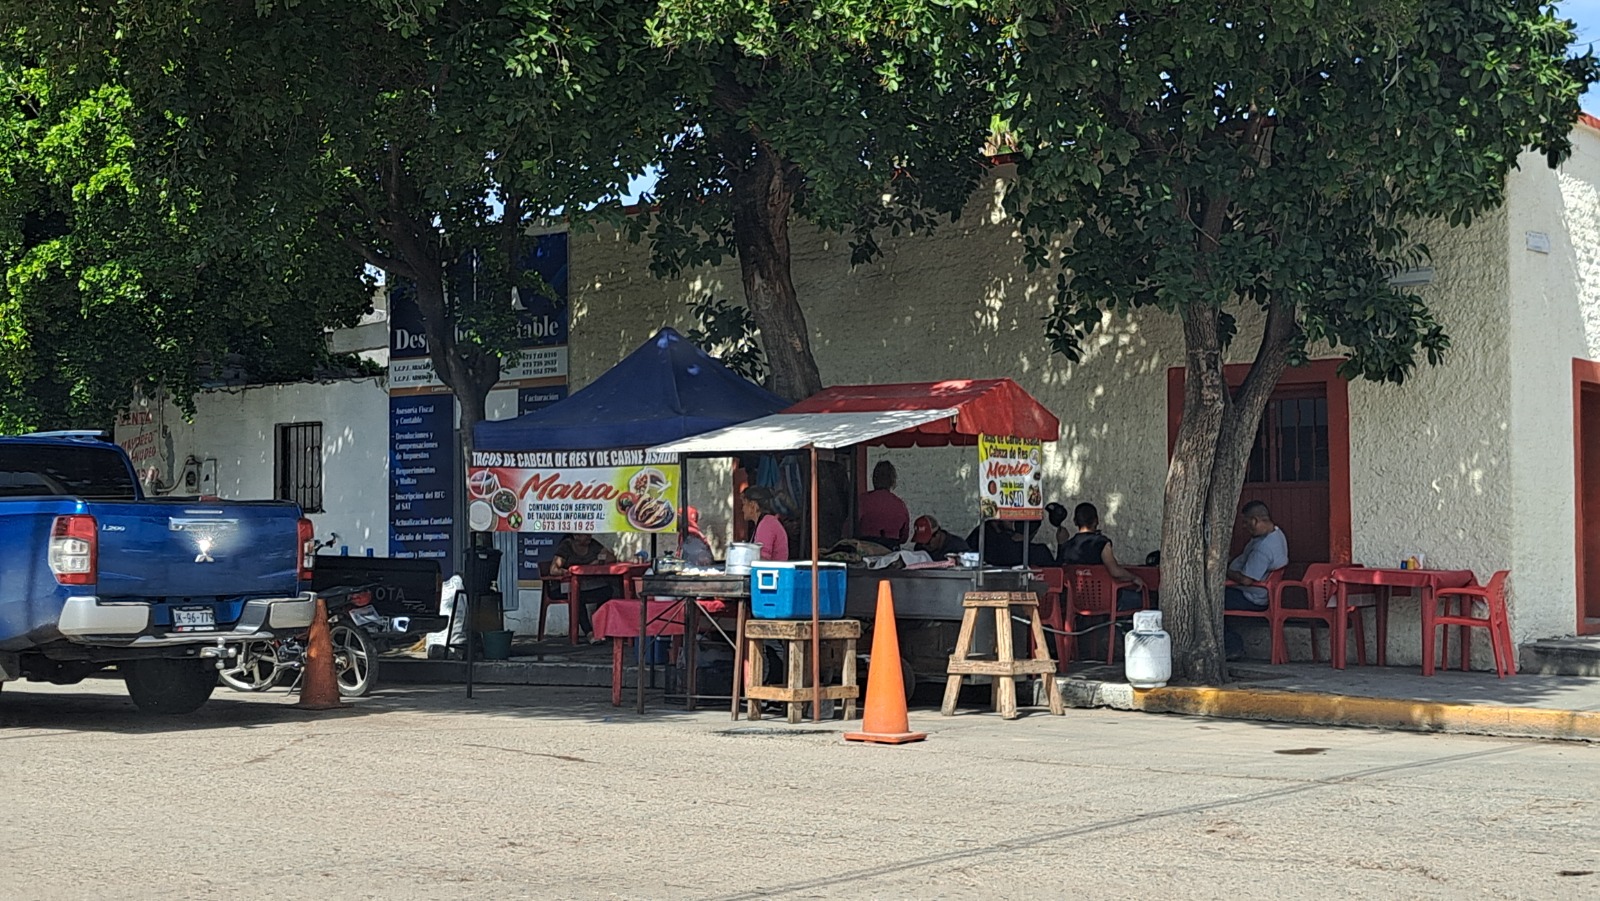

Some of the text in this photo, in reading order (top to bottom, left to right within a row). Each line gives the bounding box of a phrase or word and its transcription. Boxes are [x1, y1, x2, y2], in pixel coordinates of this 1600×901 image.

[418, 405, 434, 414] Fiscal
[396, 432, 429, 440] Devoluciones
[396, 441, 438, 452] Compensaciones
[402, 451, 430, 461] Impuestos
[1009, 446, 1016, 459] de
[1017, 447, 1028, 459] Res
[472, 451, 502, 467] TACOS
[504, 452, 516, 467] DE
[517, 452, 554, 467] CABEZA
[555, 452, 568, 467] DE
[588, 451, 596, 466] Y
[597, 451, 609, 466] DE
[610, 450, 644, 465] CARNE
[396, 466, 436, 476] Requerimientos
[986, 461, 1033, 479] María
[519, 472, 620, 501] María
[425, 491, 433, 499] del
[434, 490, 446, 499] RFC
[396, 502, 411, 511] al SAT
[430, 516, 453, 525] Contable
[536, 512, 562, 520] TAQUIZAS
[542, 521, 556, 531] 673
[558, 521, 571, 531] 133
[585, 521, 594, 531] 25
[415, 532, 422, 540] de
[422, 531, 450, 542] Impuestos
